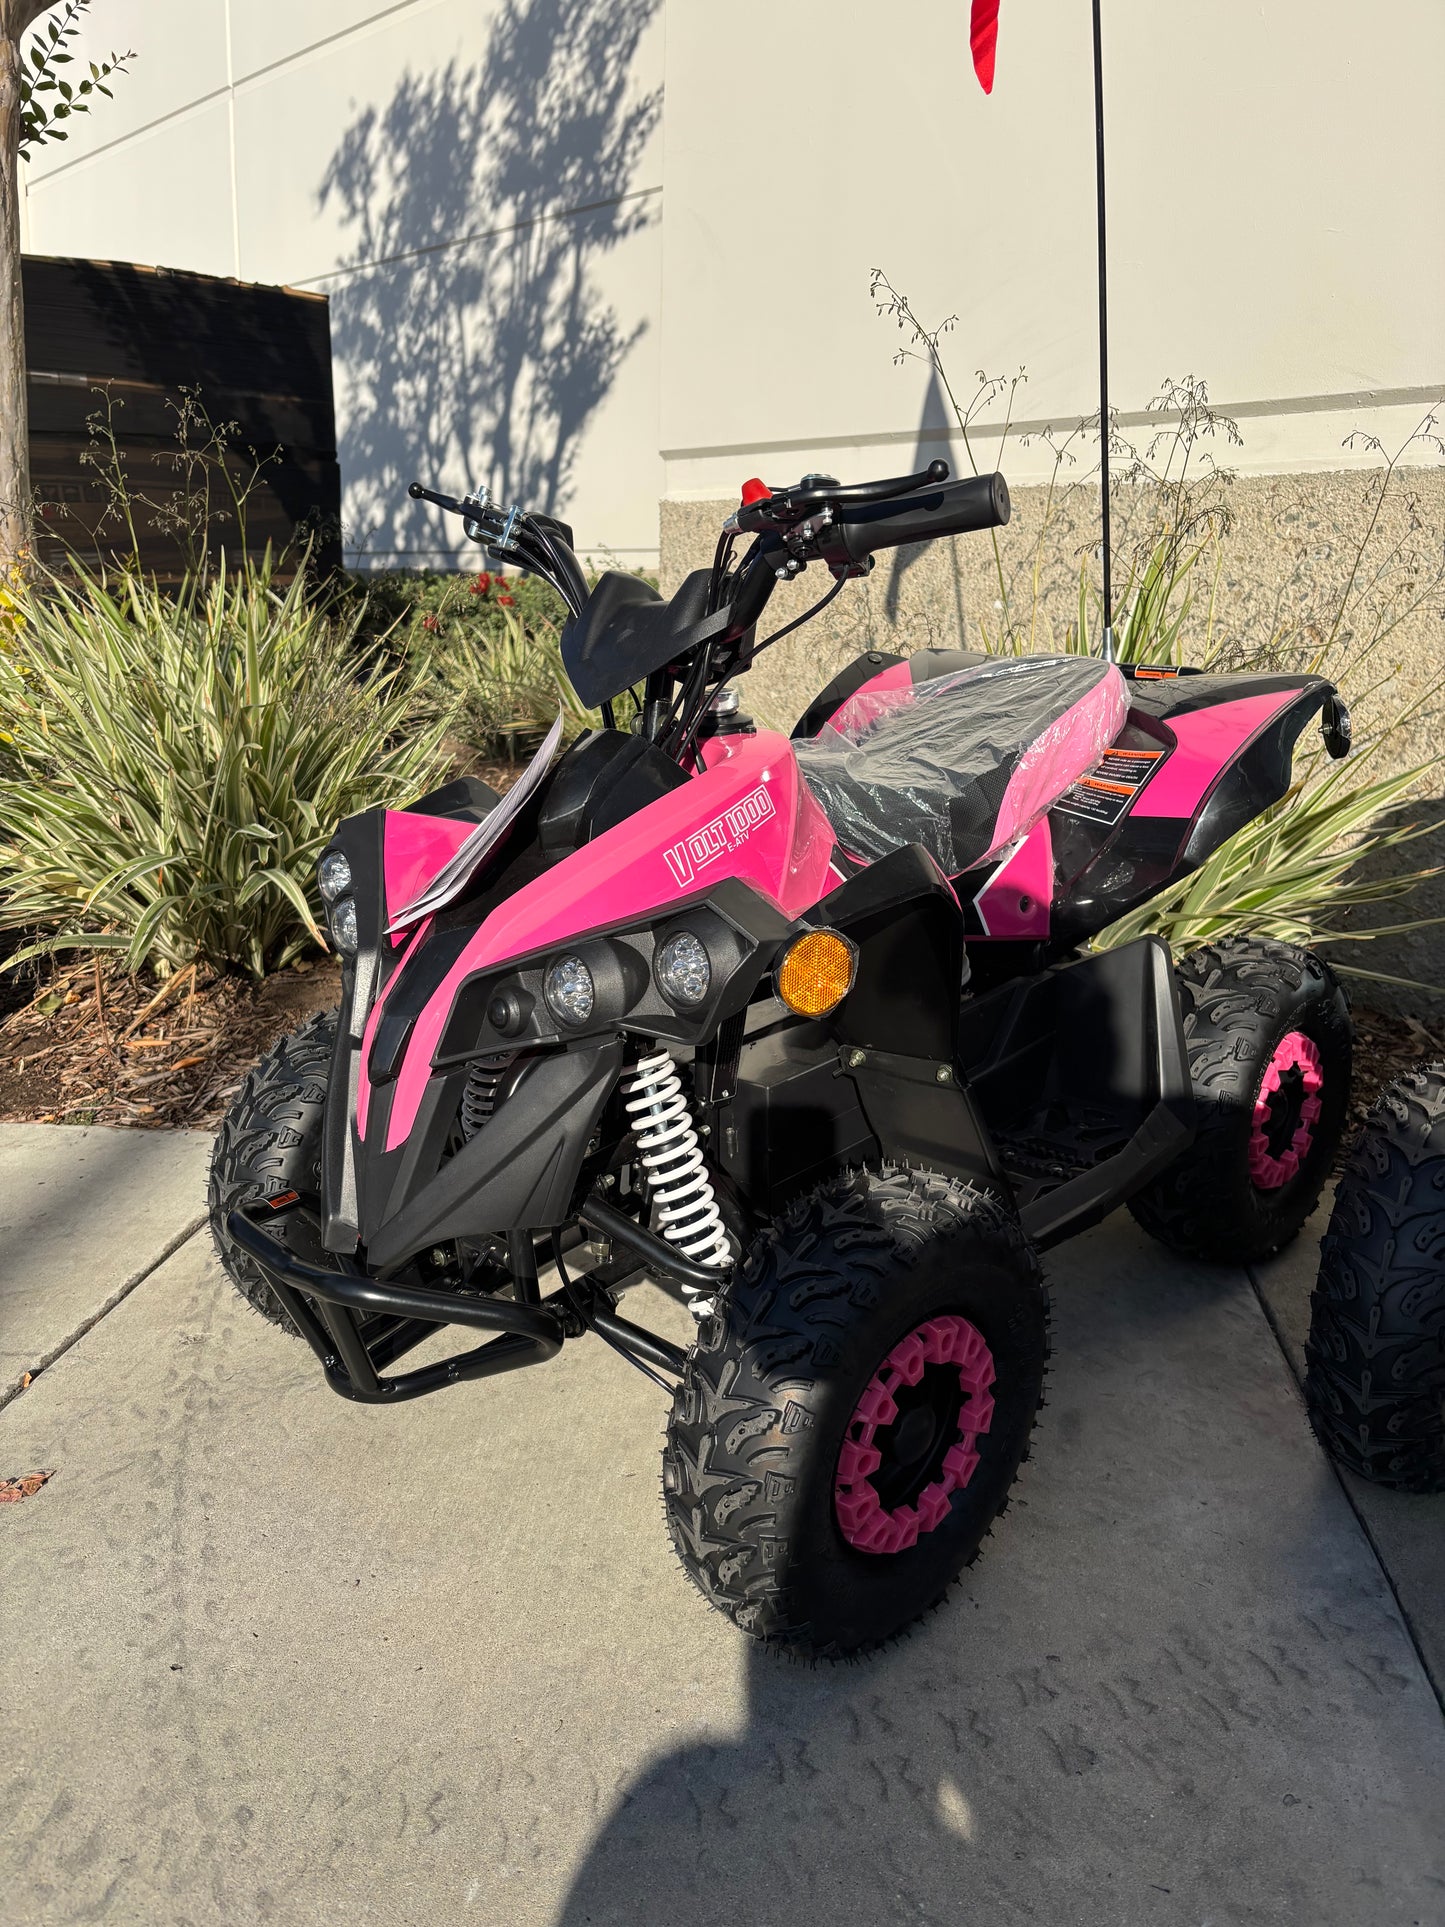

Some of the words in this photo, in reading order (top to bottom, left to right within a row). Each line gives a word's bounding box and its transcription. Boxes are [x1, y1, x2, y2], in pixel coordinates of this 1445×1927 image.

[662, 820, 728, 888] VOLT
[725, 790, 771, 837] 1000
[727, 830, 750, 853] E-ATV
